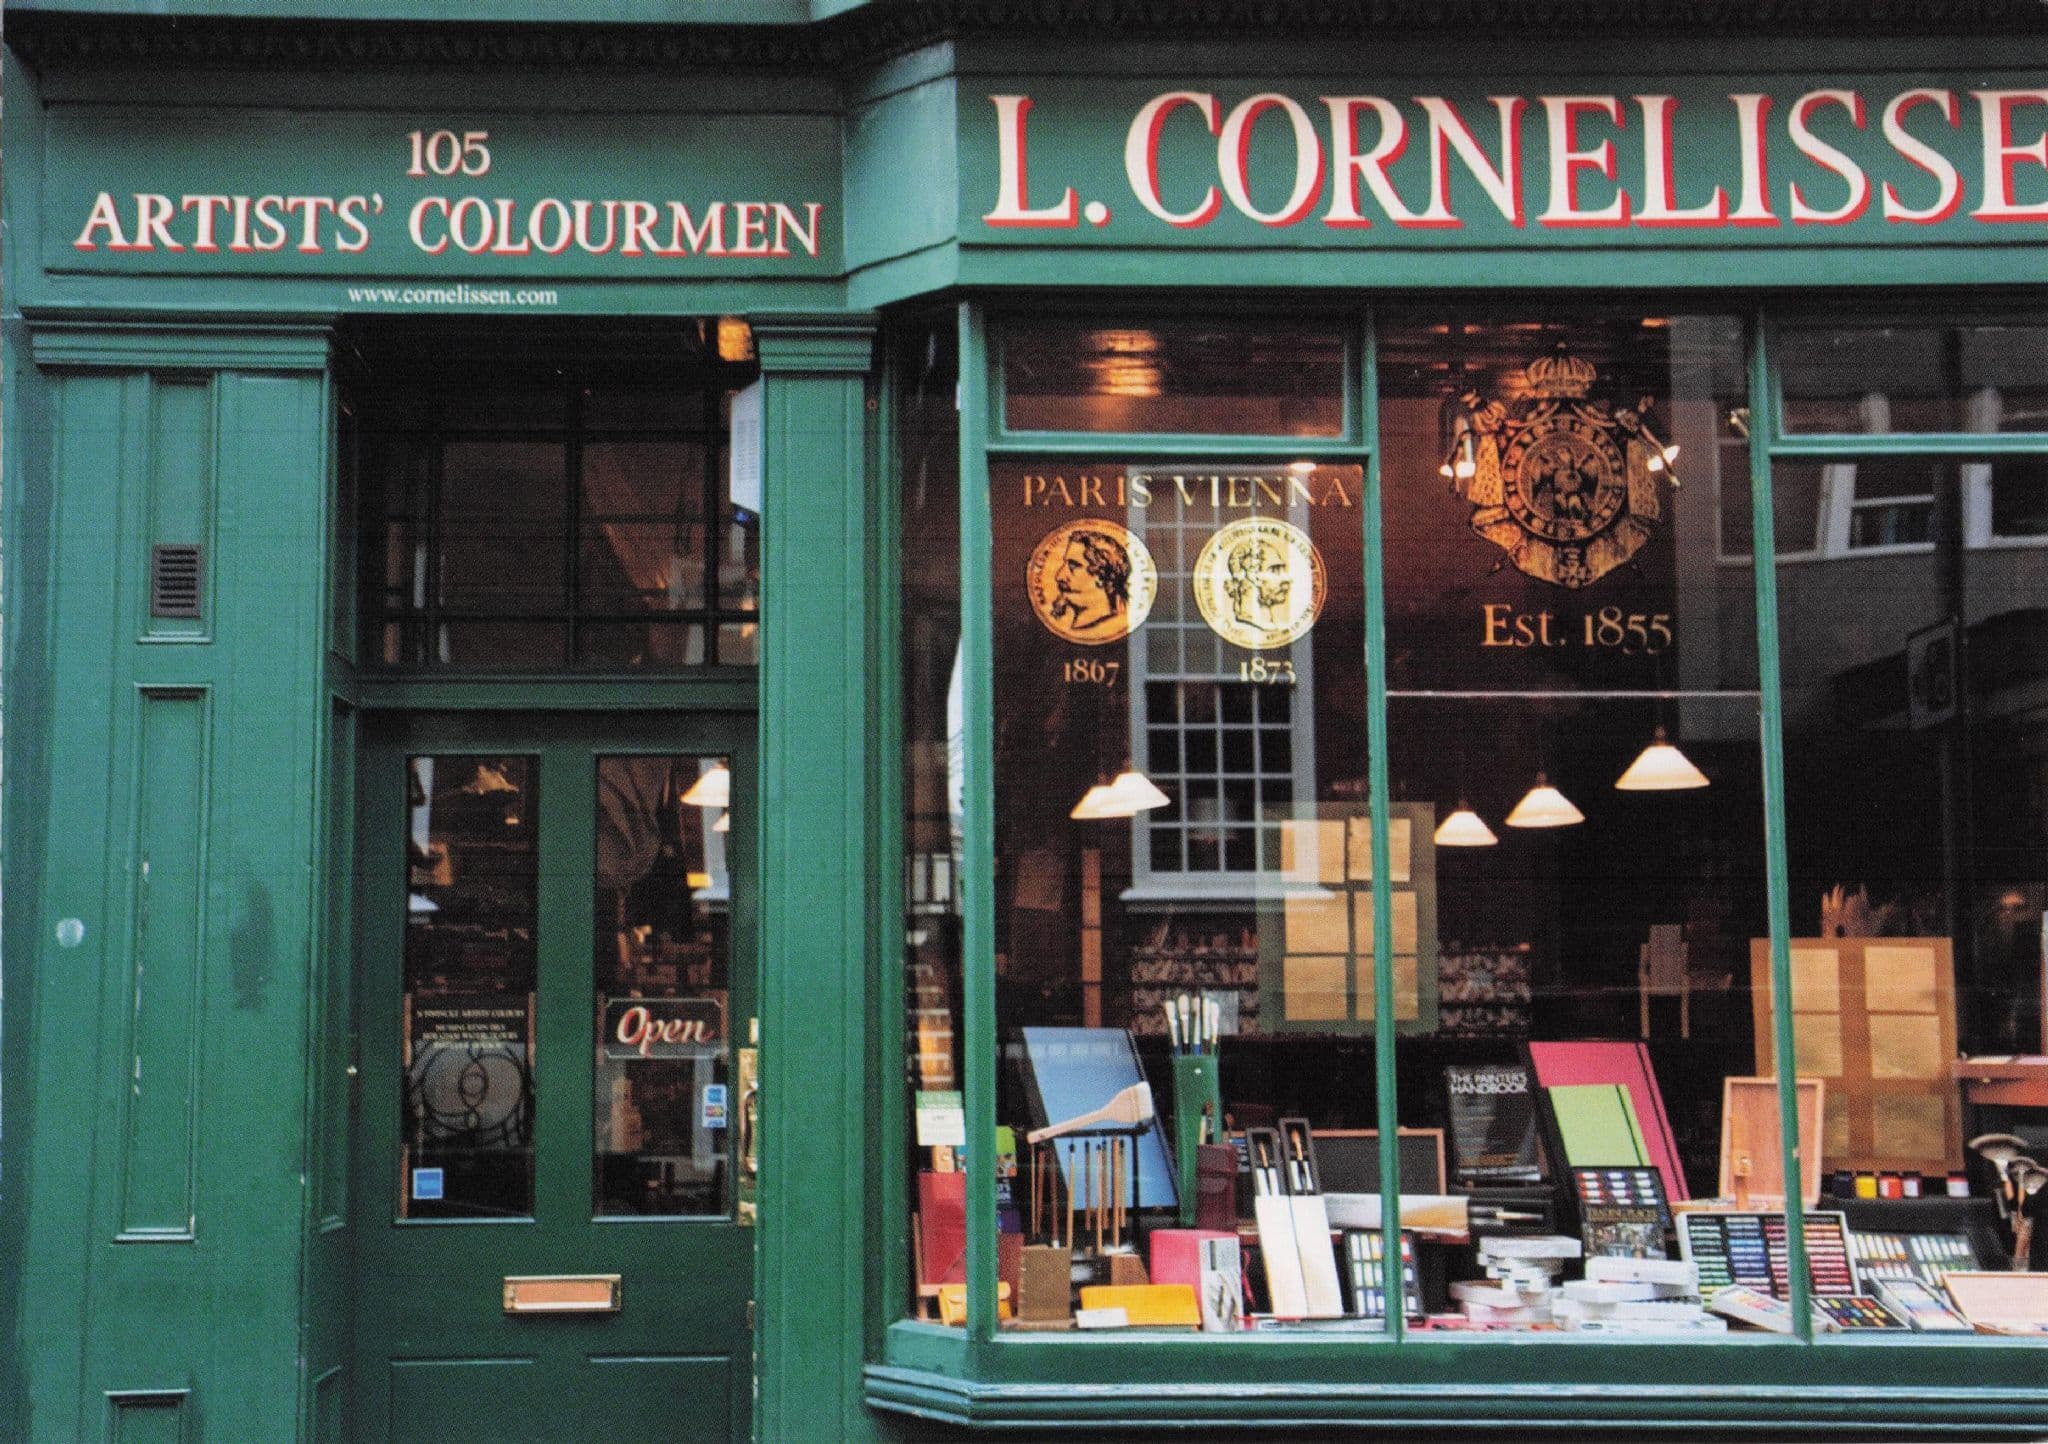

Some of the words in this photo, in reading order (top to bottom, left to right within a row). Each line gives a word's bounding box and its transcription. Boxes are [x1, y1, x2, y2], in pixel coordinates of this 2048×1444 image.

[406, 129, 492, 178] 105
[982, 93, 1109, 228] L.
[1123, 89, 2048, 228] CORNELISSE
[73, 190, 385, 255] ARTISTS’
[408, 196, 824, 258] COLOURMEN
[347, 284, 559, 307] www.cornelissen.com
[1023, 474, 1152, 508] PARIS
[1173, 474, 1353, 508] VIENNA
[1481, 602, 1567, 648] Est.
[1584, 604, 1672, 656] 1855
[1062, 656, 1120, 688] 1867
[1240, 656, 1297, 685] 1873
[616, 1005, 715, 1057] Open
[1450, 1082, 1529, 1095] HANDBOOK
